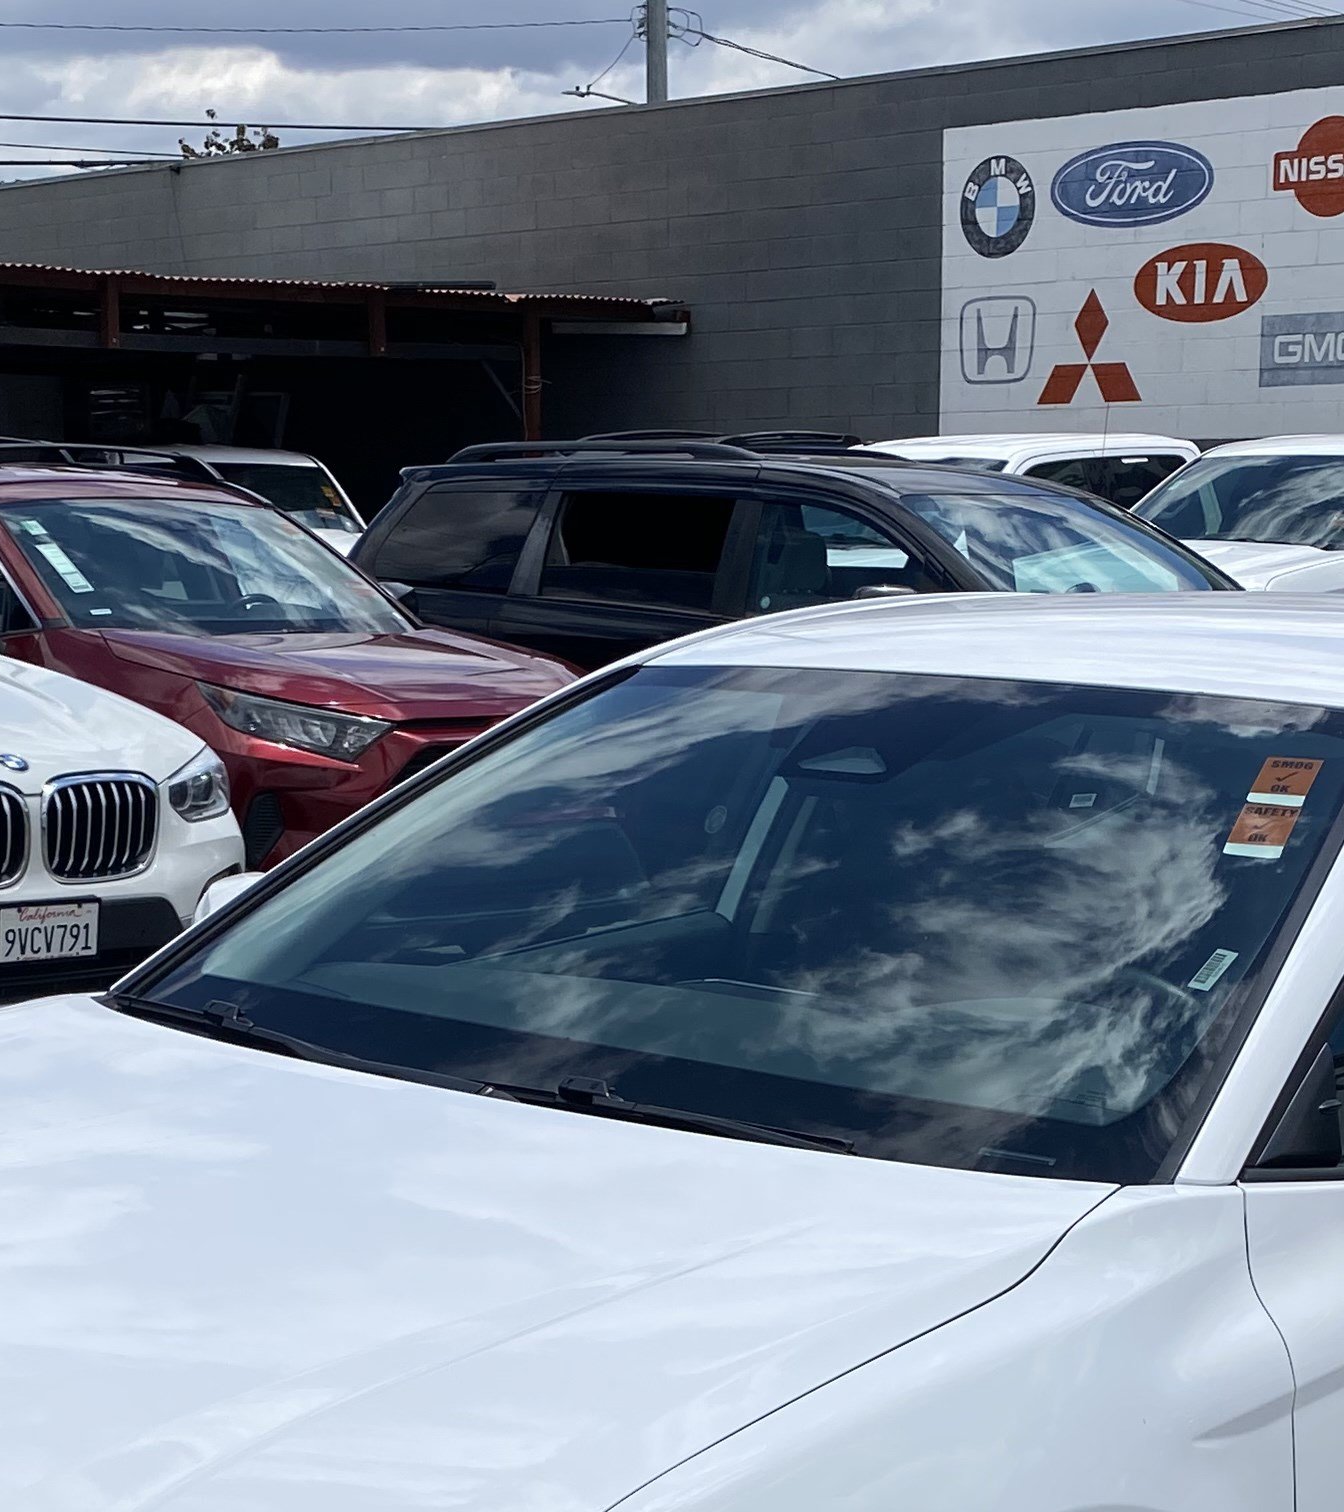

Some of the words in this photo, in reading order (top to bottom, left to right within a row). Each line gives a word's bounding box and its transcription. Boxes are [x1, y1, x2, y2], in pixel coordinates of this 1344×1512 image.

[963, 156, 1033, 202] BMW
[1085, 158, 1177, 208] Ford
[1154, 258, 1248, 306] KIA
[1271, 760, 1314, 770] SMOG
[1270, 784, 1290, 793] OK
[1244, 806, 1299, 817] SAFETY
[18, 907, 82, 924] California
[5, 923, 91, 957] 9VCV791
